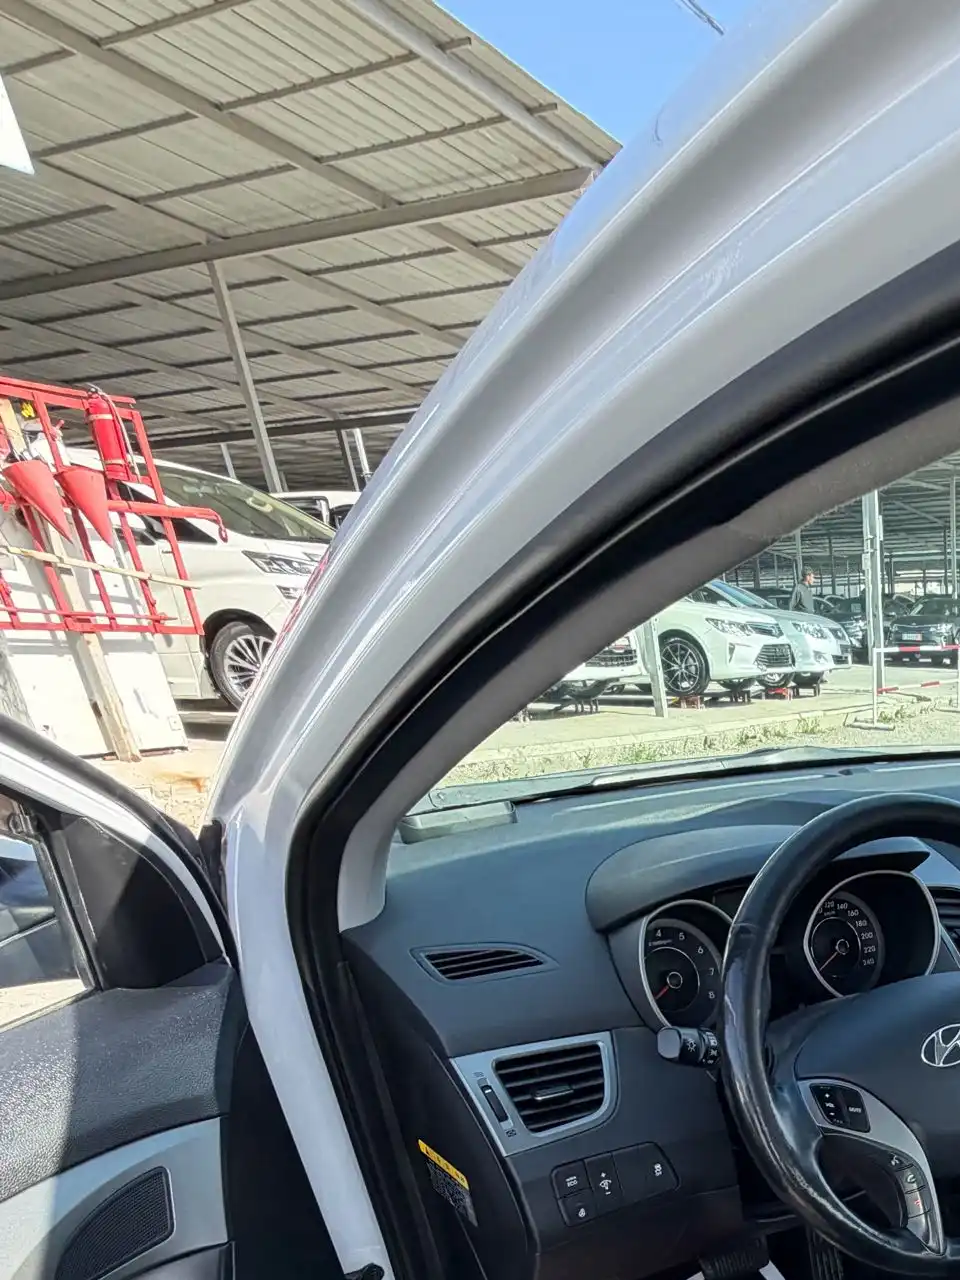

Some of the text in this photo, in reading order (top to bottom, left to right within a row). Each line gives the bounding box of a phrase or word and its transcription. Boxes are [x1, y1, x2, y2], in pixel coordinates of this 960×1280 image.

[655, 929, 662, 937] 4
[679, 932, 686, 940] 5
[861, 932, 873, 940] 200
[697, 946, 704, 954] 6
[708, 967, 715, 976] 7
[708, 991, 715, 999] 8
